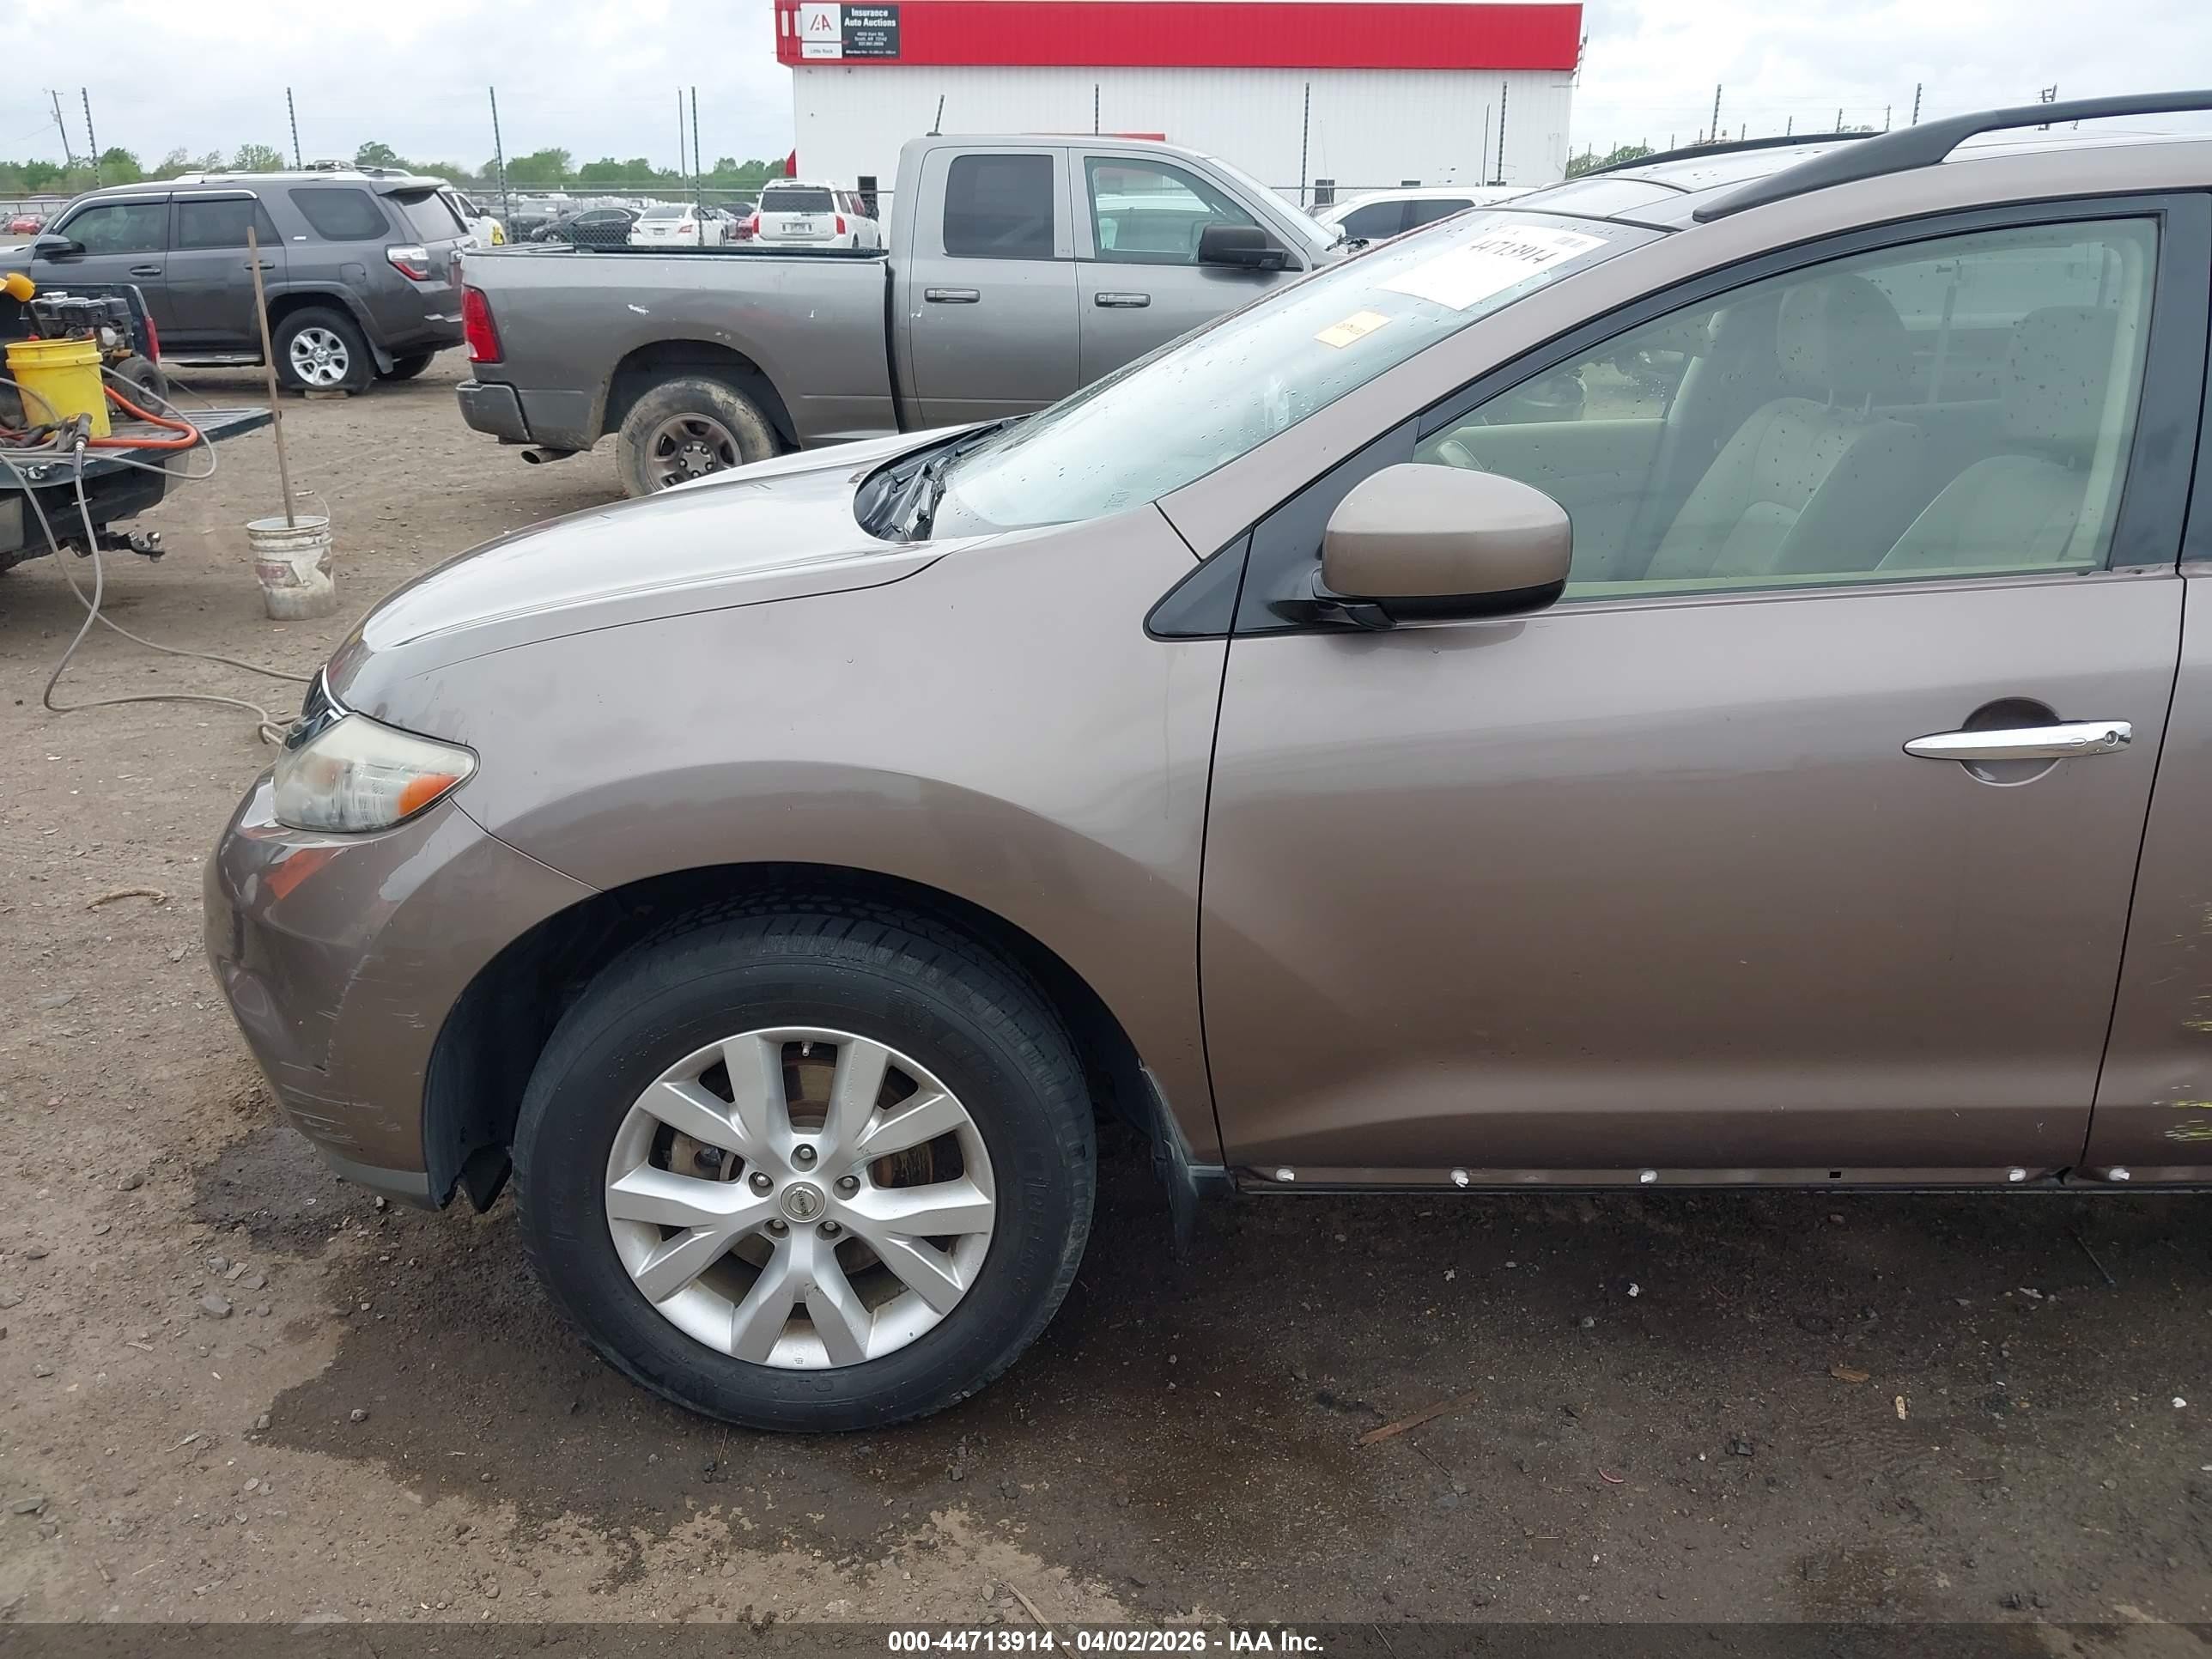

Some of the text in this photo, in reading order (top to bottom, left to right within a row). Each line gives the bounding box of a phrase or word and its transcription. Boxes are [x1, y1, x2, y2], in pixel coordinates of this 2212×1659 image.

[851, 8, 889, 17] Insurance
[844, 17, 896, 27] Auto Auctions
